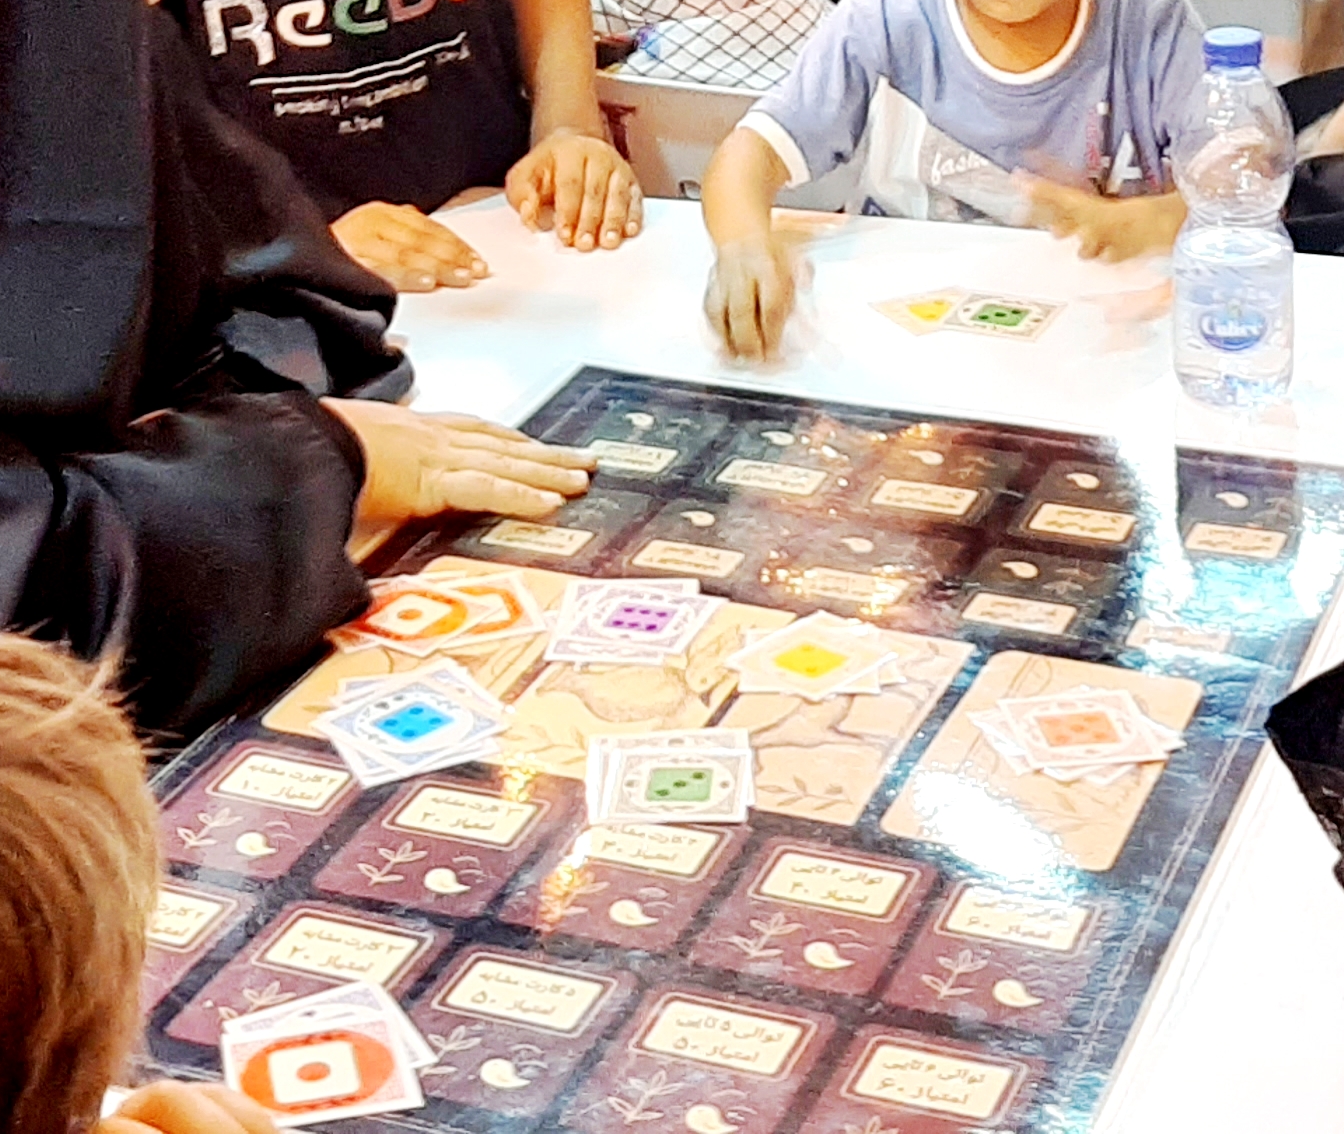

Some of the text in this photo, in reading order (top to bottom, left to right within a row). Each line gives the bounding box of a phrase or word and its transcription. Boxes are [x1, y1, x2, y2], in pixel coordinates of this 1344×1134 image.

[272, 786, 322, 802] امتیاز
[448, 817, 496, 831] امتیاز
[820, 889, 869, 904] امتیاز
[318, 954, 374, 972] امتیاز
[470, 990, 556, 1015] امتیاز ۵۰
[732, 1026, 785, 1044] توالی
[672, 1036, 760, 1062] امتیاز ۵۰
[937, 1068, 986, 1084] توالی
[908, 1086, 970, 1104] امتیاز
